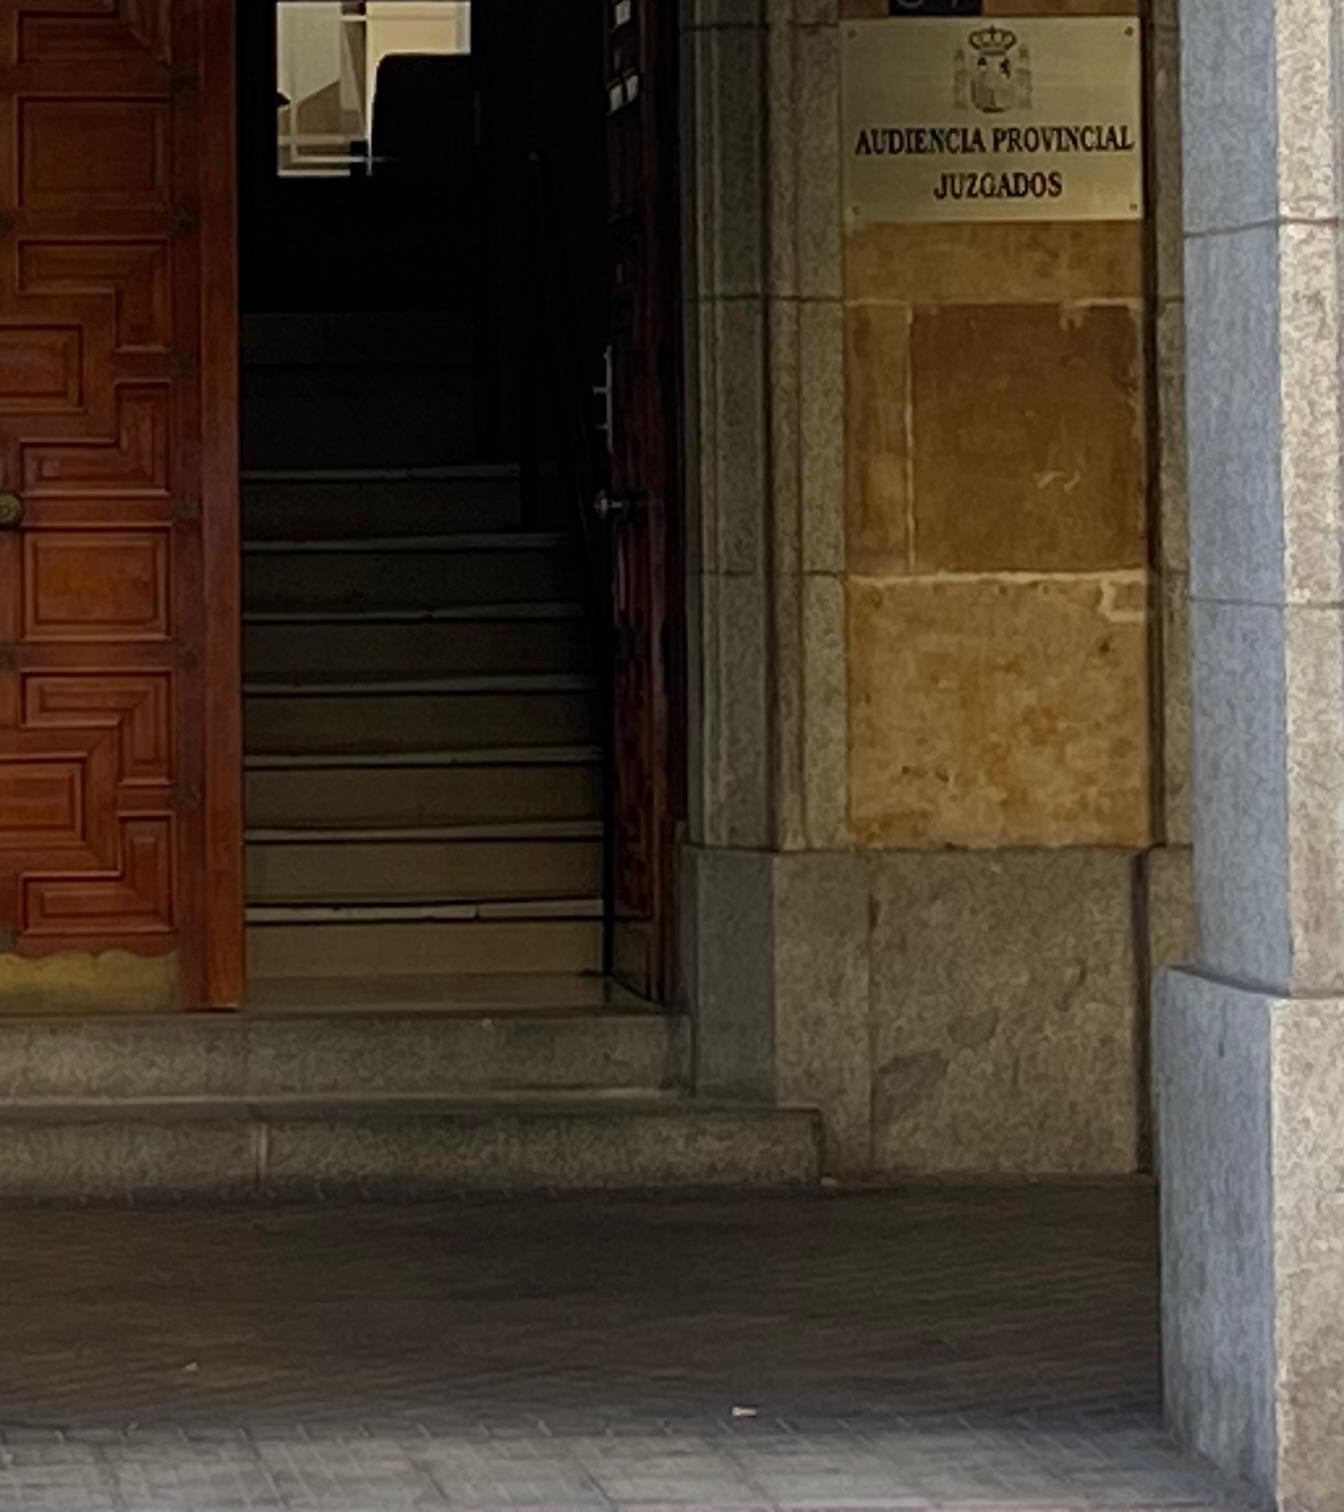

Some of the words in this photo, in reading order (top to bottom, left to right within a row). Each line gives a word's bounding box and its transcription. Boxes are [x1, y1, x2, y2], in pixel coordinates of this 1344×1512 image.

[855, 127, 986, 155] AUDIENCIA
[993, 125, 1135, 153] PROVINCIAL
[934, 172, 1063, 200] JUZGADOS
